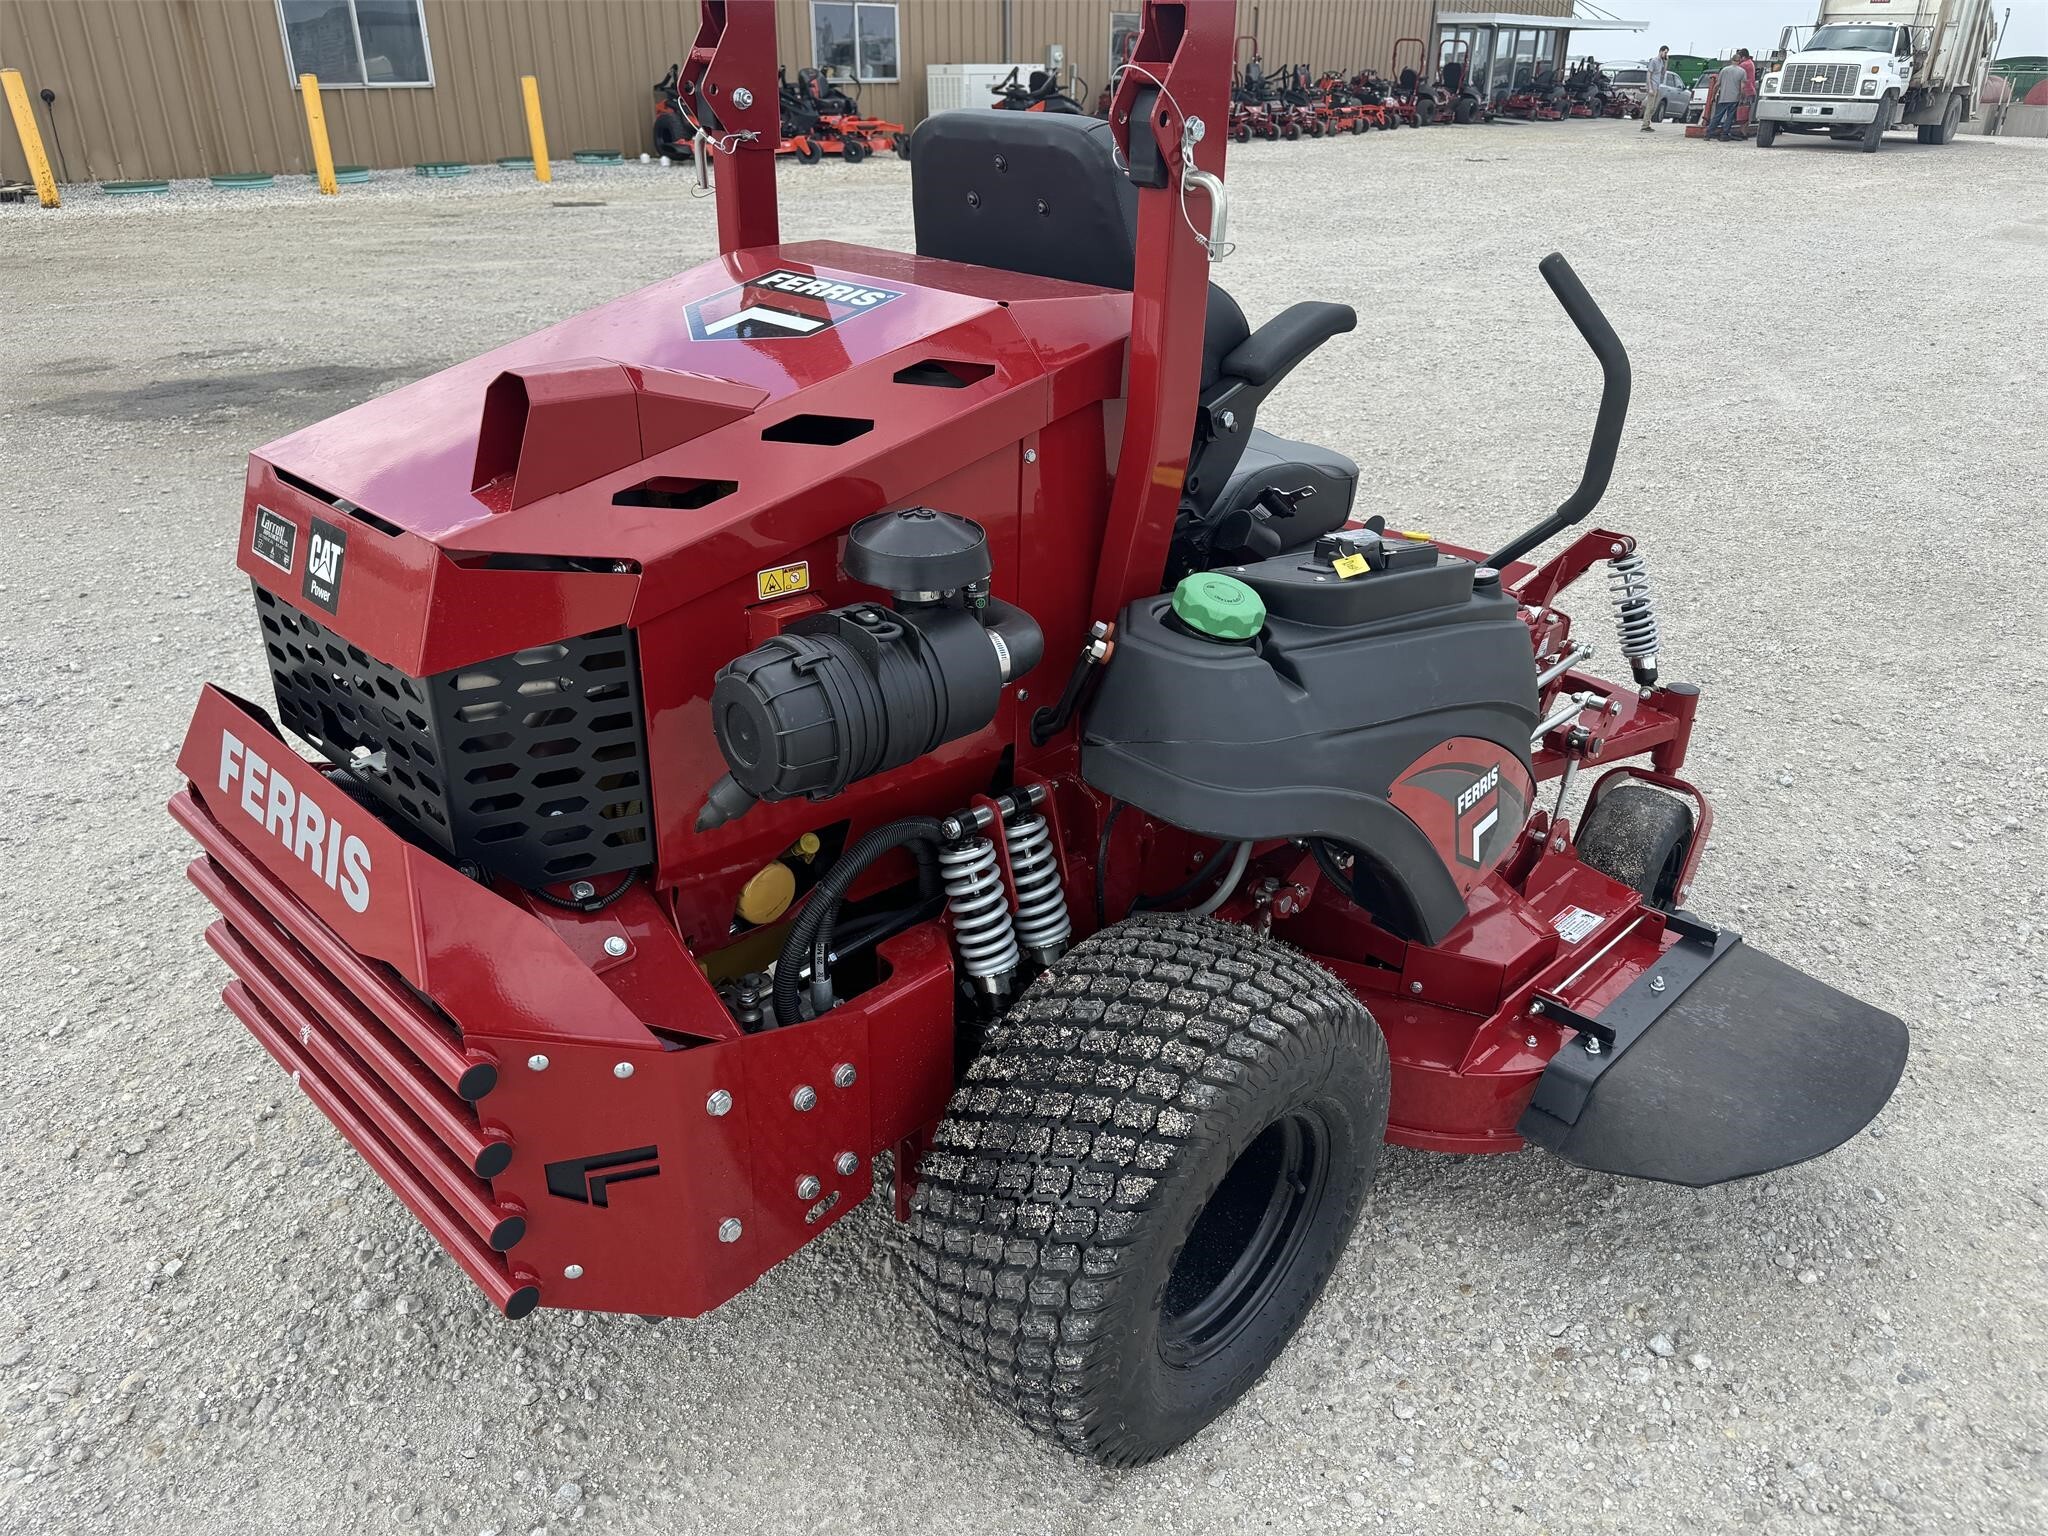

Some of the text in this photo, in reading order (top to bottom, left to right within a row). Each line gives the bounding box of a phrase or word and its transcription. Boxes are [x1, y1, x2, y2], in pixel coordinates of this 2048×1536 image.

[757, 272, 887, 306] FERRIS
[309, 534, 341, 585] CAT
[310, 580, 331, 602] Power
[1457, 769, 1499, 816] FERRIS
[218, 728, 372, 913] FERRIS
